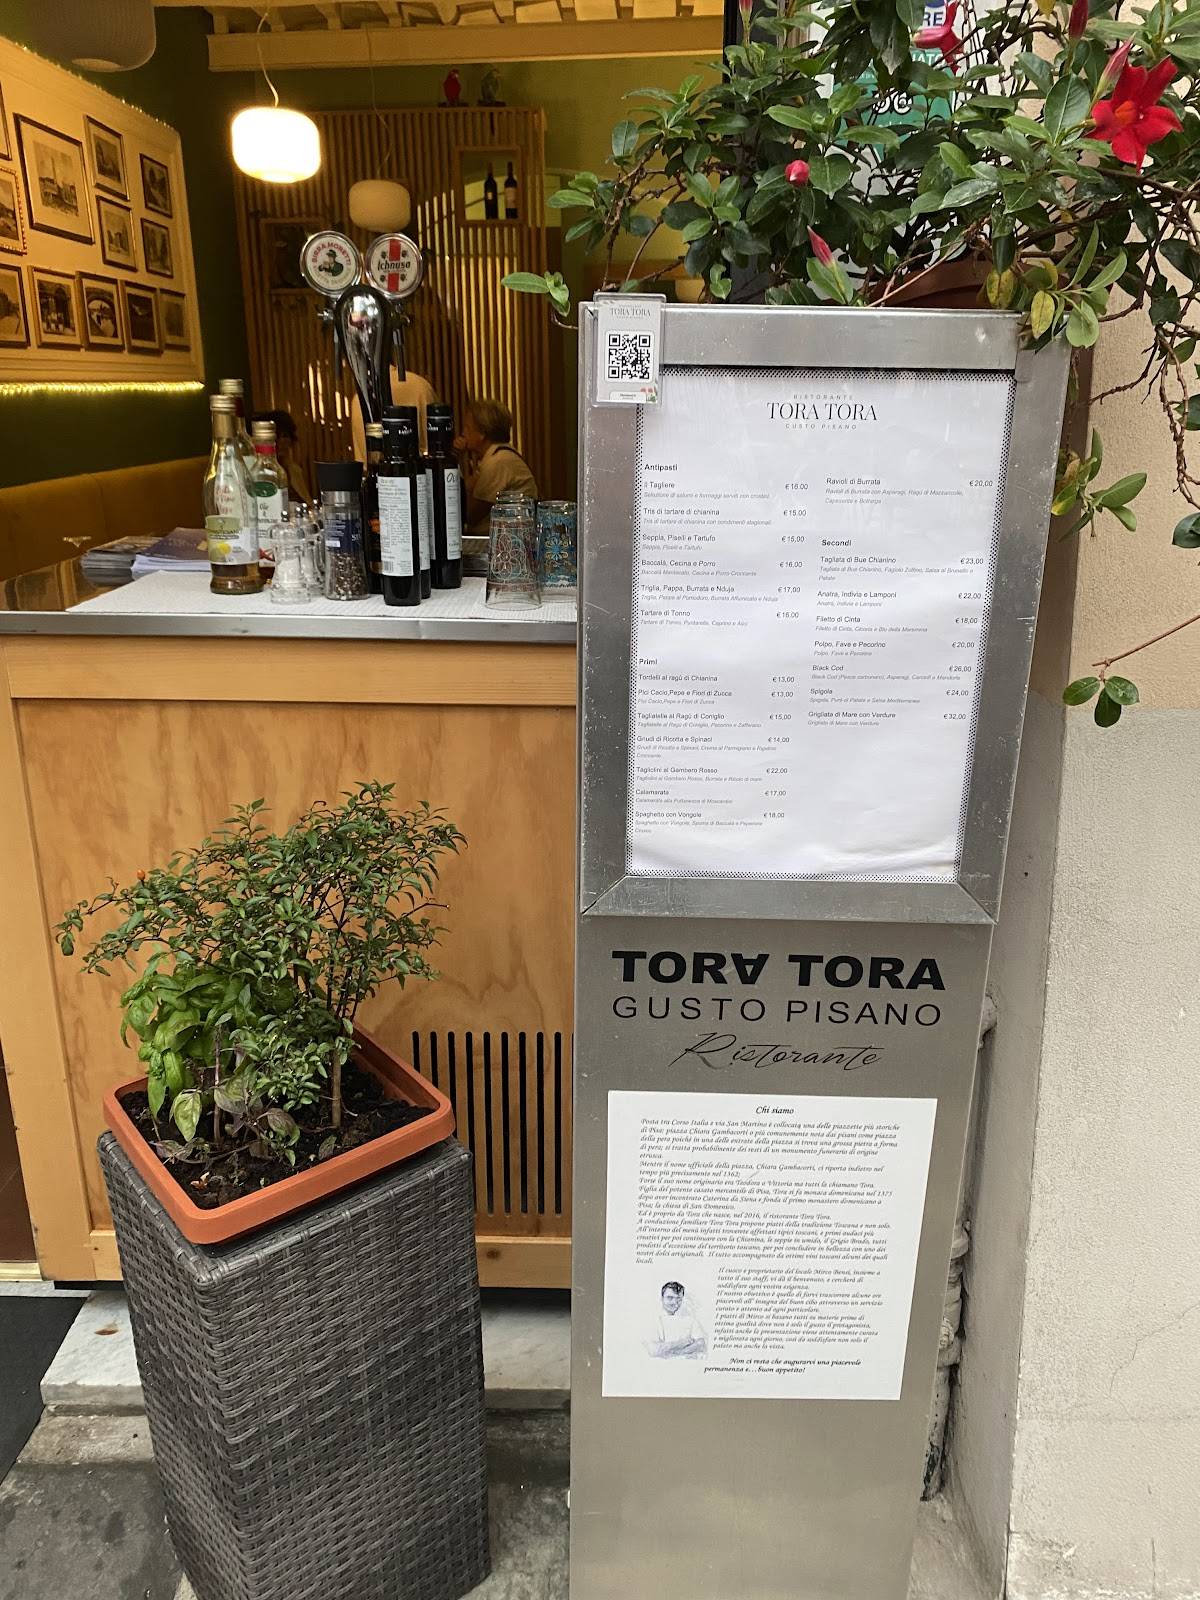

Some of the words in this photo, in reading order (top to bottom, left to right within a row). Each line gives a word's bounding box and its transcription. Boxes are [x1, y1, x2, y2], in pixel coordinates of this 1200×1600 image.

[377, 260, 411, 271] Ichnusa
[793, 393, 853, 401] RISTORANTE
[767, 403, 819, 419] TORA
[825, 404, 876, 420] TORA
[644, 463, 678, 473] Antipasti
[821, 539, 852, 547] Secondi
[788, 954, 945, 990] TORA
[613, 996, 765, 1021] GUSTO
[787, 1000, 940, 1026] PISANO
[667, 1031, 886, 1071] Ristorante
[755, 1105, 771, 1115] Chi
[771, 1106, 795, 1115] siamo
[729, 1357, 745, 1365] Non
[817, 1358, 830, 1366] una
[830, 1359, 862, 1368] piacevole
[703, 1366, 744, 1374] permanenza
[775, 1367, 806, 1375] appetito!
